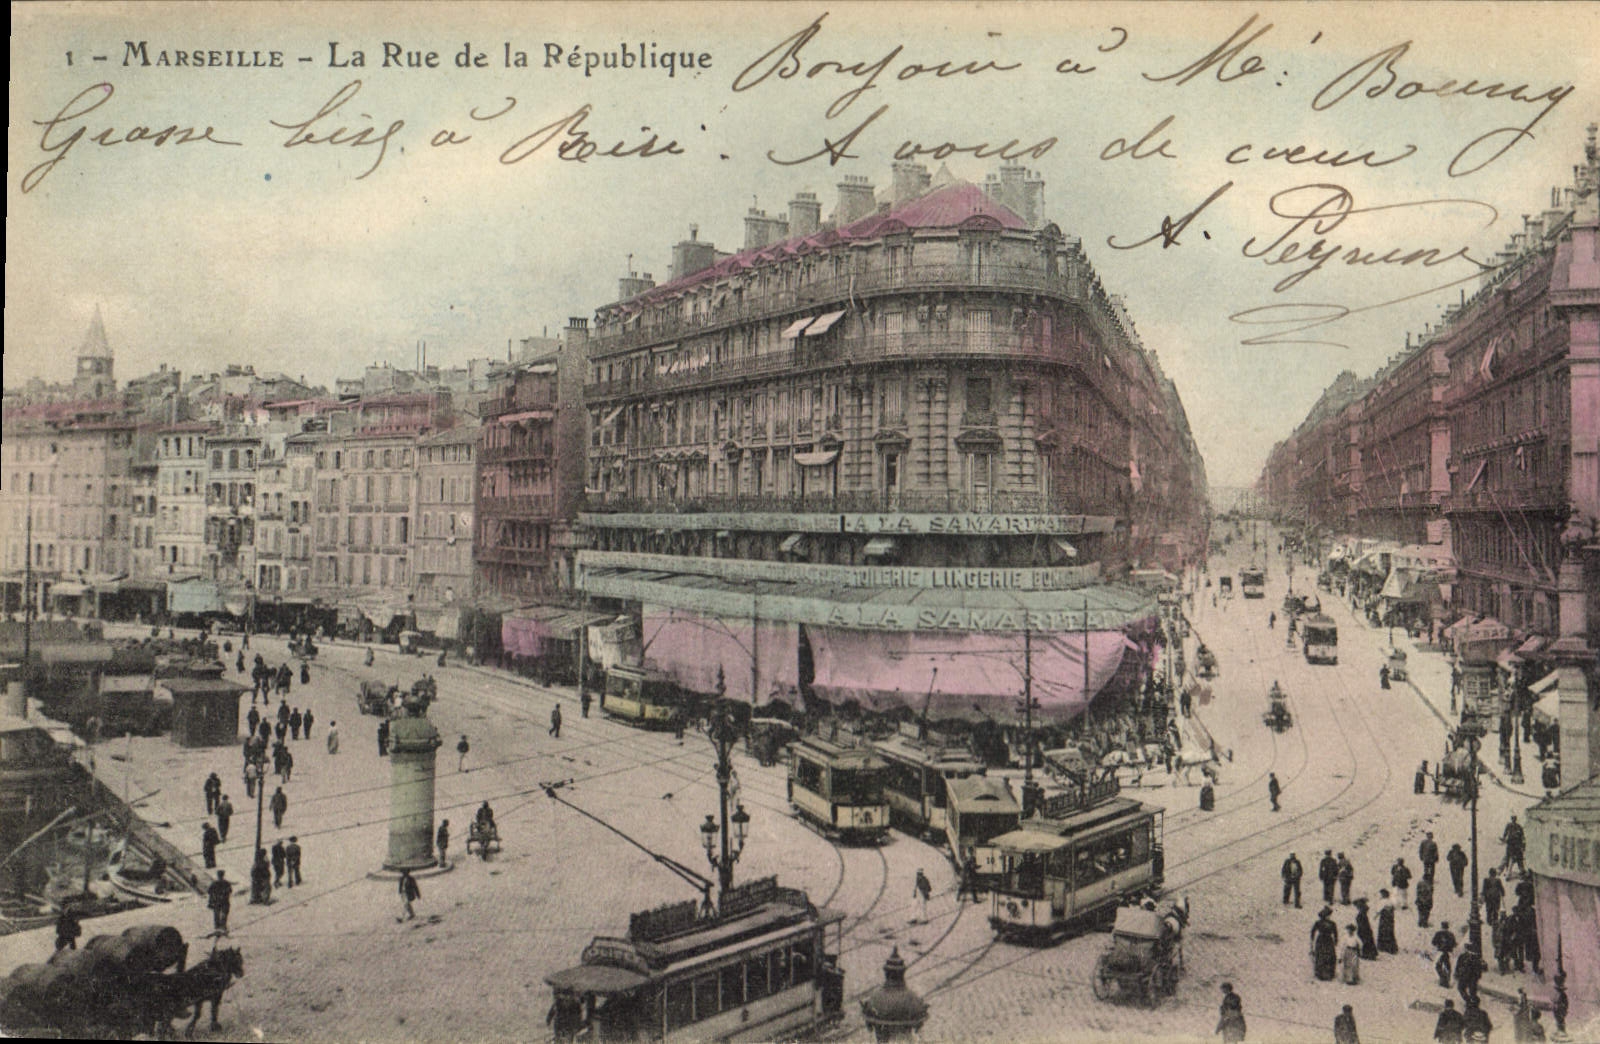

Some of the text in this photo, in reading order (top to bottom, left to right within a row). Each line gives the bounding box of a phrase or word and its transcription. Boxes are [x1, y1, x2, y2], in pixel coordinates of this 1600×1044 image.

[1099, 113, 1178, 161] de
[931, 569, 1022, 589] LINGERIE
[827, 606, 849, 626] A
[857, 606, 903, 628] LA
